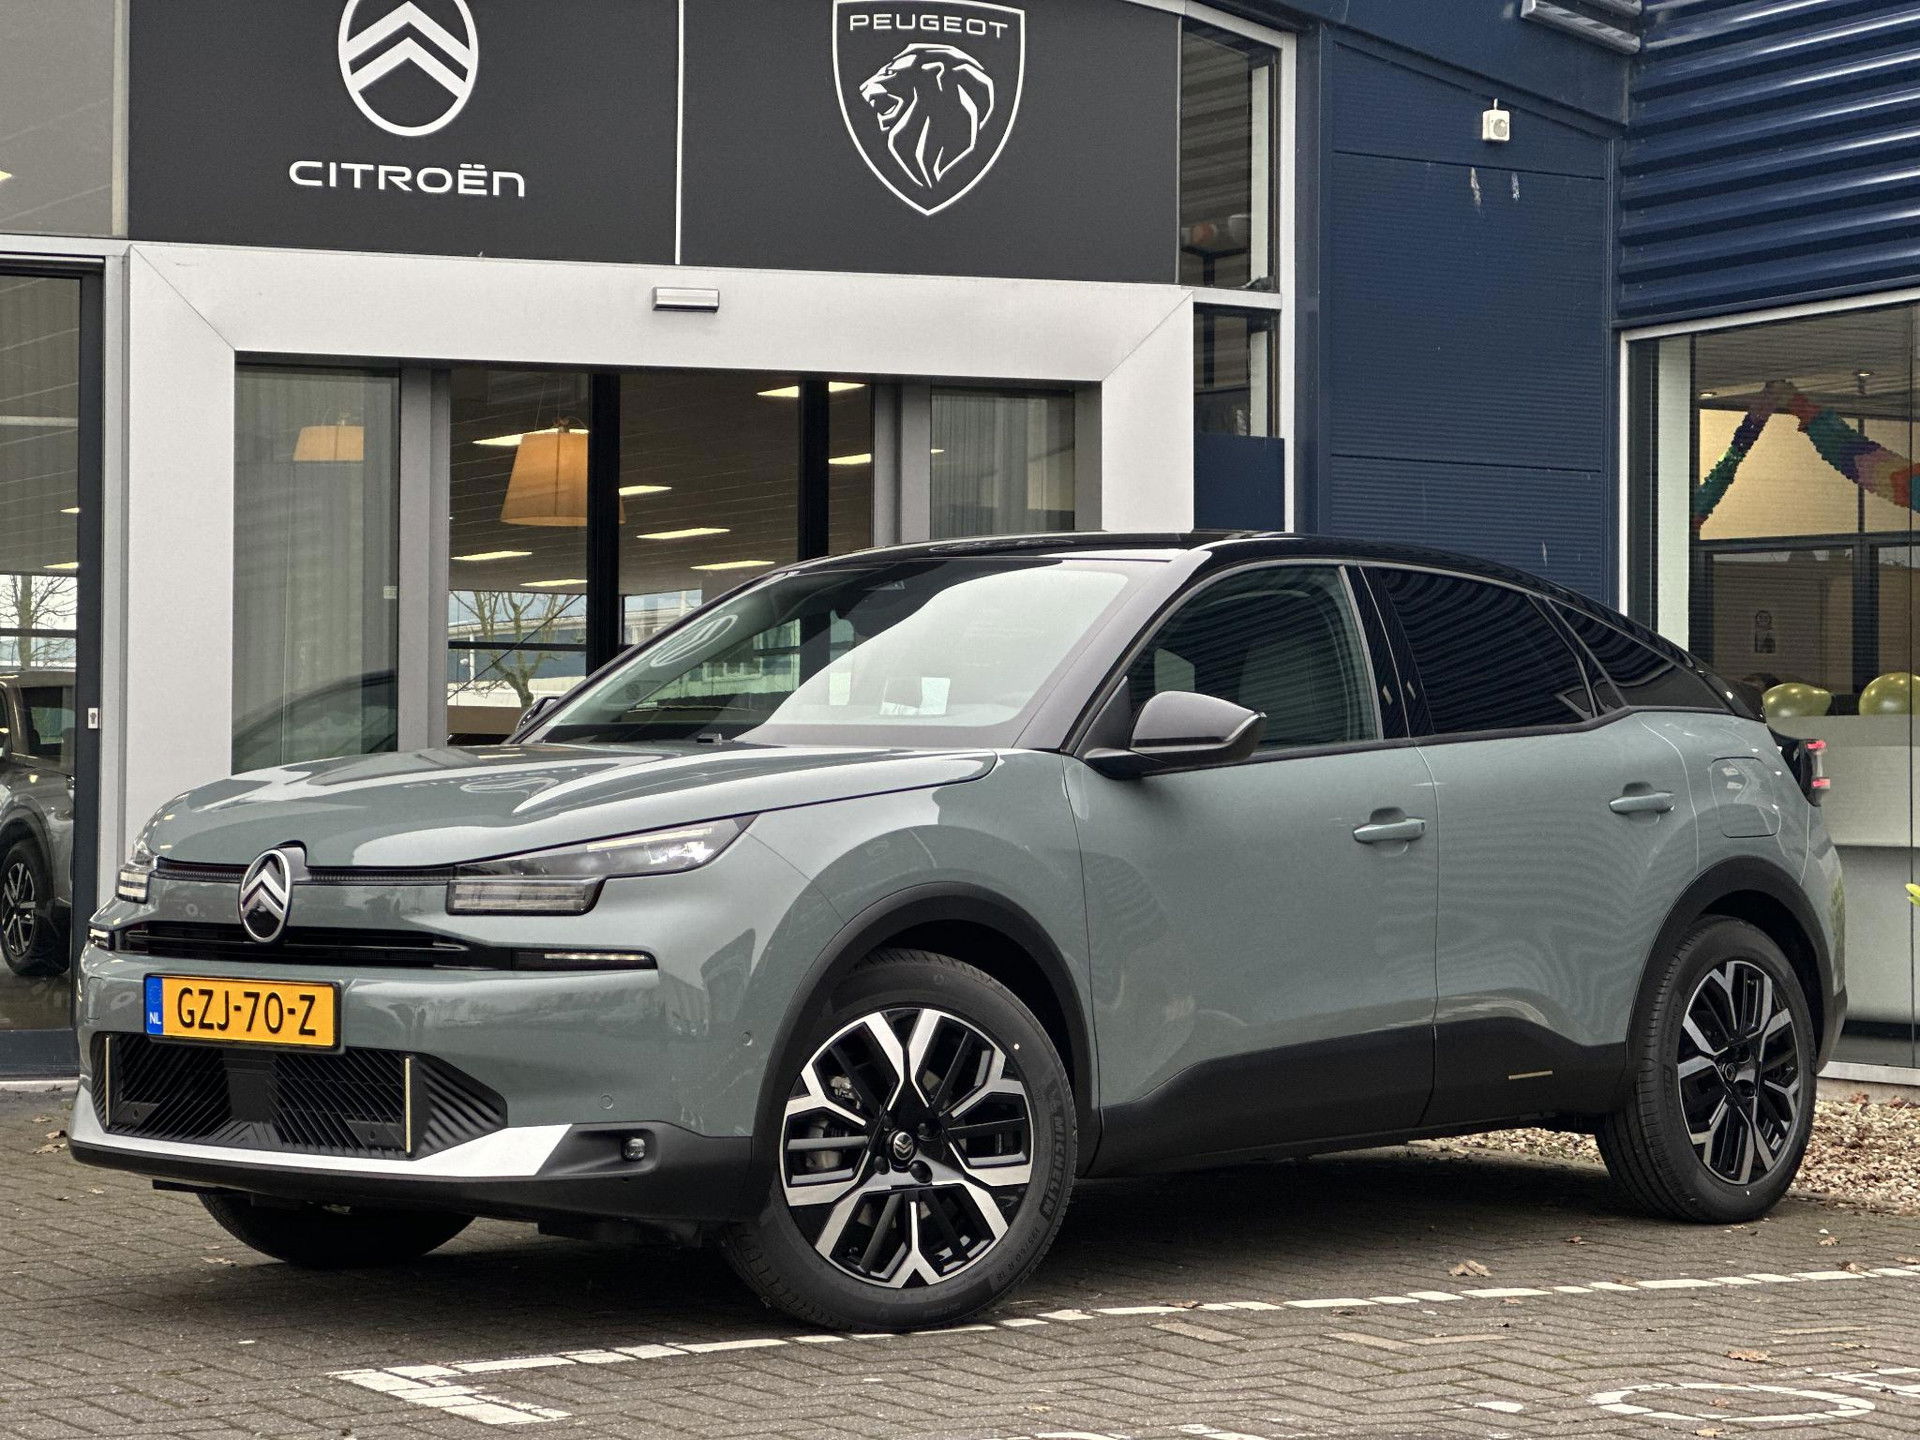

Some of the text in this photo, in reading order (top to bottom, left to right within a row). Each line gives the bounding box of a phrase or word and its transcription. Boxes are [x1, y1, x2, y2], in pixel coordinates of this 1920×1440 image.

[849, 13, 1008, 38] PEUGEOT
[149, 1011, 162, 1025] NL
[177, 987, 316, 1036] GZJ-70-Z
[1039, 1116, 1066, 1218] MICHELIN
